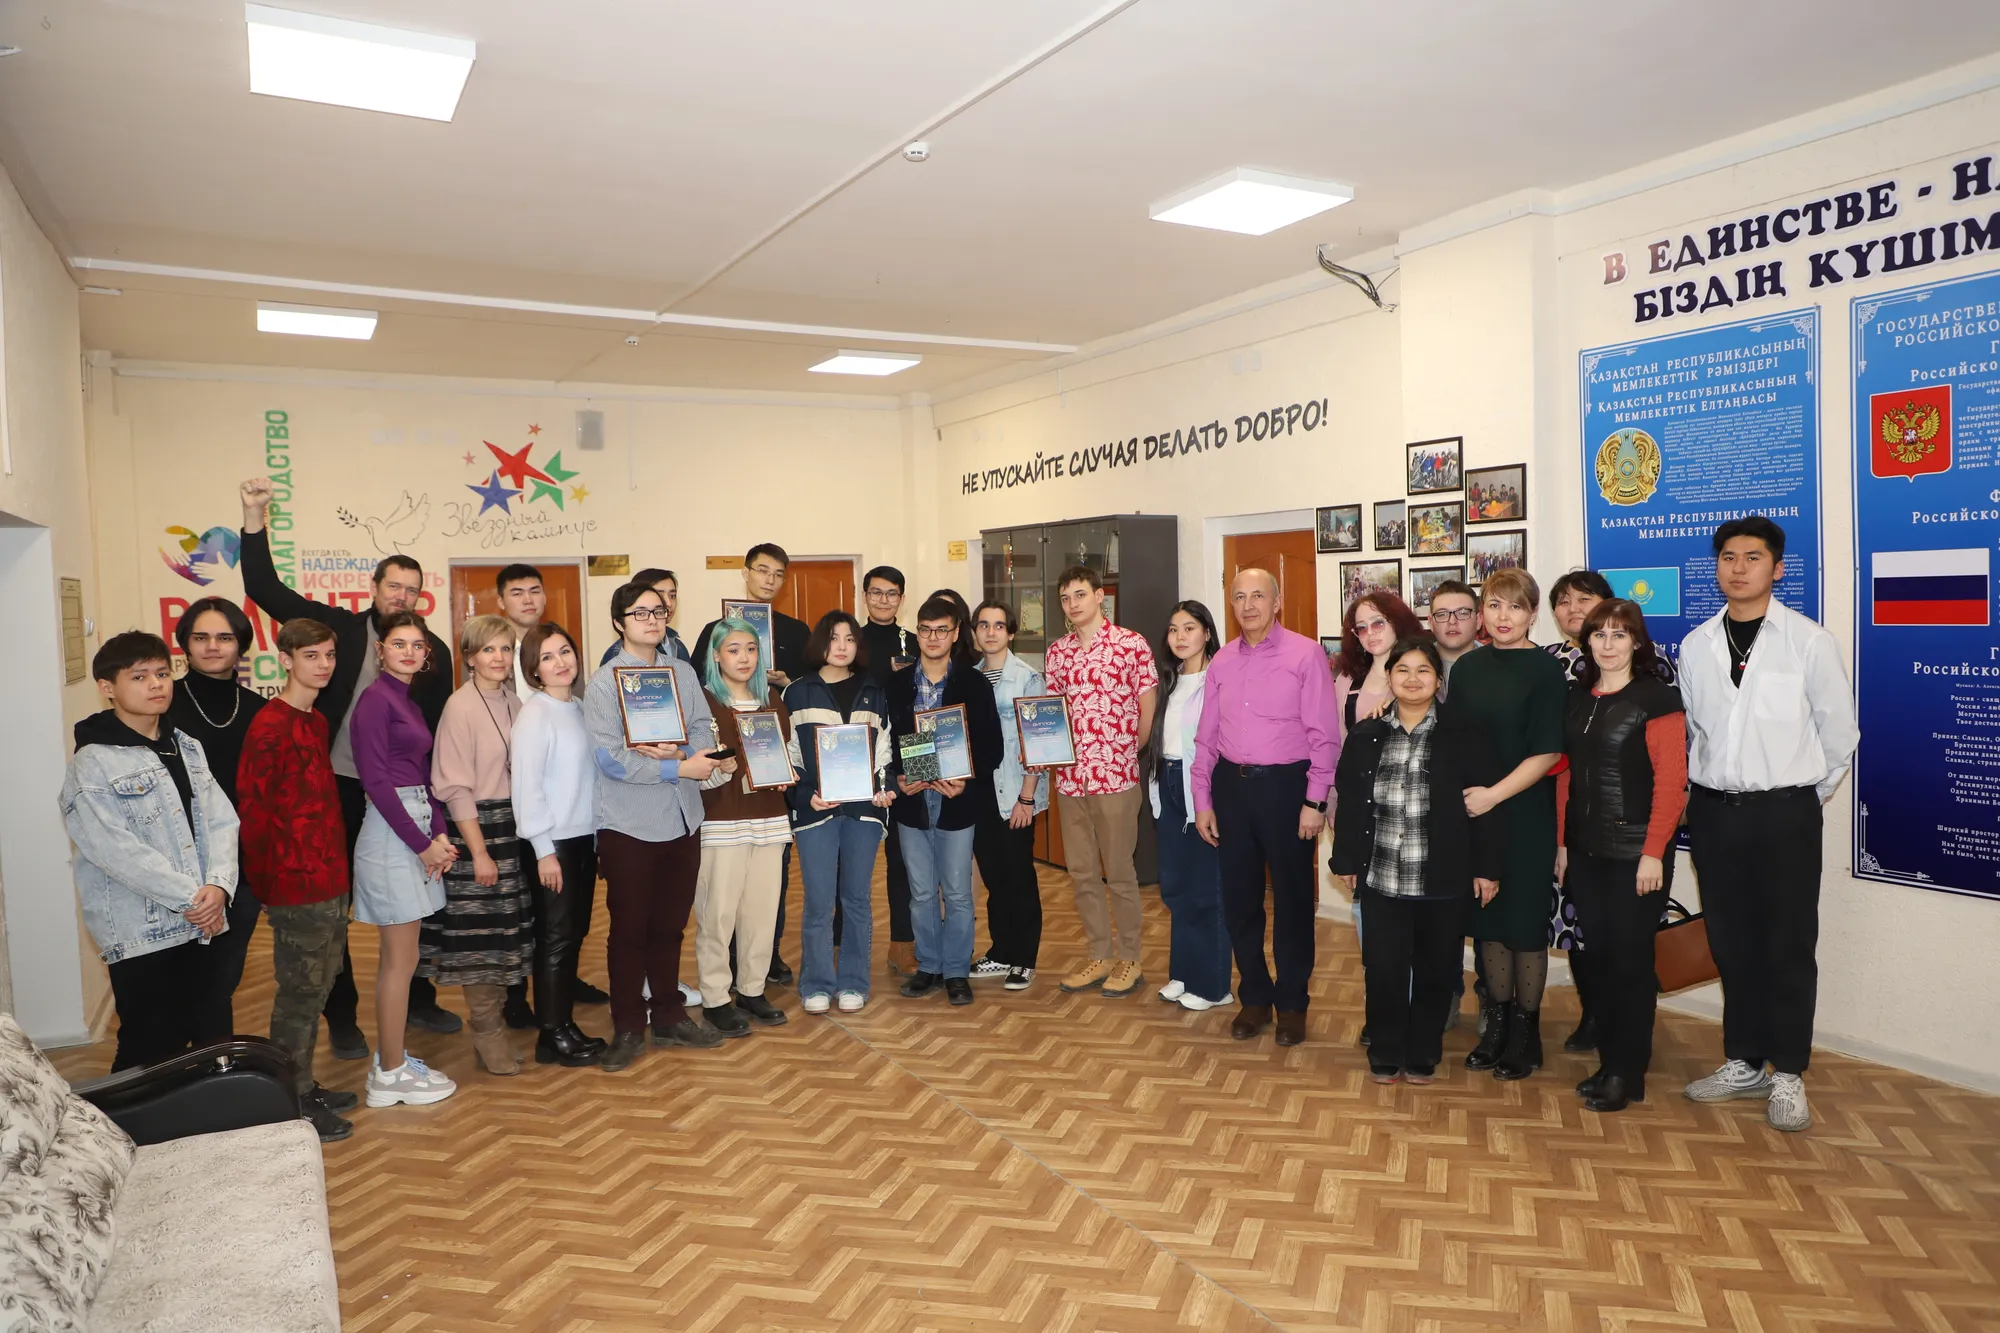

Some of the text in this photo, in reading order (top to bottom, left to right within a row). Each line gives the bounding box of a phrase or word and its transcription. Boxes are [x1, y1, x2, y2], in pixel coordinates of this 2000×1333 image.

[1602, 252, 1627, 285] В
[1647, 181, 1898, 275] ЕДИНСТВЕ
[1952, 156, 2000, 201] Н
[1633, 261, 1786, 323] БІЗДІҢ
[1876, 300, 2000, 335] ГОСУДАРСТВЕ
[1590, 337, 1806, 384] ҚАЗАҚСТАН РЕСПУБЛИКАСЫНЫҢ
[1612, 356, 1779, 393] МЕМЛЕКЕТТІК РӘМІЗДЕРІ
[962, 472, 979, 495] НЕ
[982, 451, 1065, 492] УПУСКАЙТЕ
[1069, 437, 1138, 478] СЛУЧАЯ
[301, 558, 378, 571] НАДЕЖДА
[302, 549, 351, 557] ВСЕГДА ЕСТЬ
